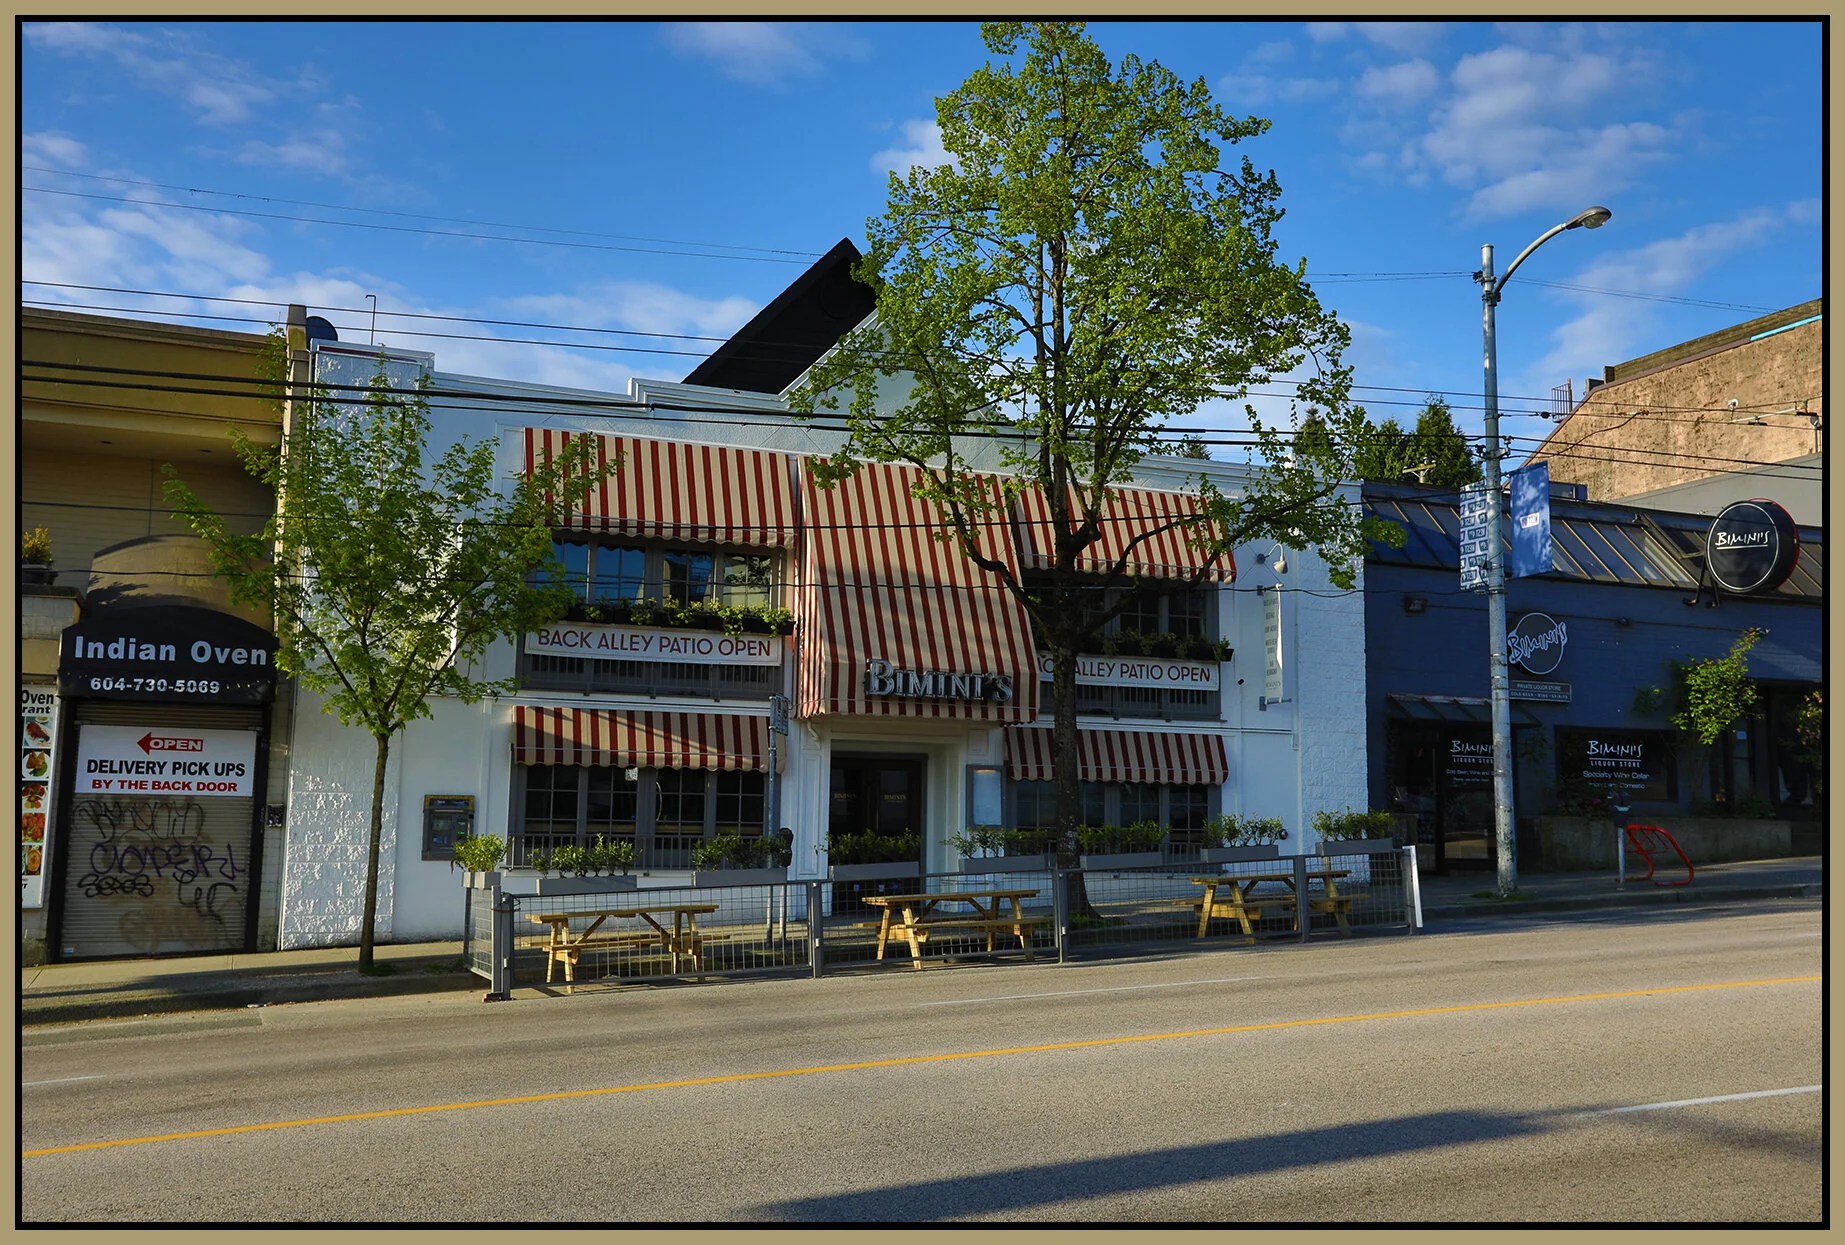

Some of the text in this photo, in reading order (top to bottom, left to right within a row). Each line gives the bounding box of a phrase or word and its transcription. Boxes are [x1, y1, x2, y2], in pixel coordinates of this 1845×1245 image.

[1715, 531, 1770, 546] BIMINI'S
[74, 635, 267, 665] Indian Oven
[538, 628, 771, 657] BACK ALLEY PATIO OPEN
[1074, 661, 1116, 678] ALLEY
[1120, 663, 1164, 680] PATIO
[1167, 665, 1211, 682] OPEN
[90, 676, 220, 694] 604-730-5069
[22, 690, 54, 704] Oven
[149, 739, 202, 751] OPEN
[1450, 740, 1494, 755] BIMINI'
[1586, 740, 1644, 758] BIMINI'S
[86, 759, 246, 777] DELIVERY PICK UPS
[91, 779, 238, 792] BY THE BACK DOOR
